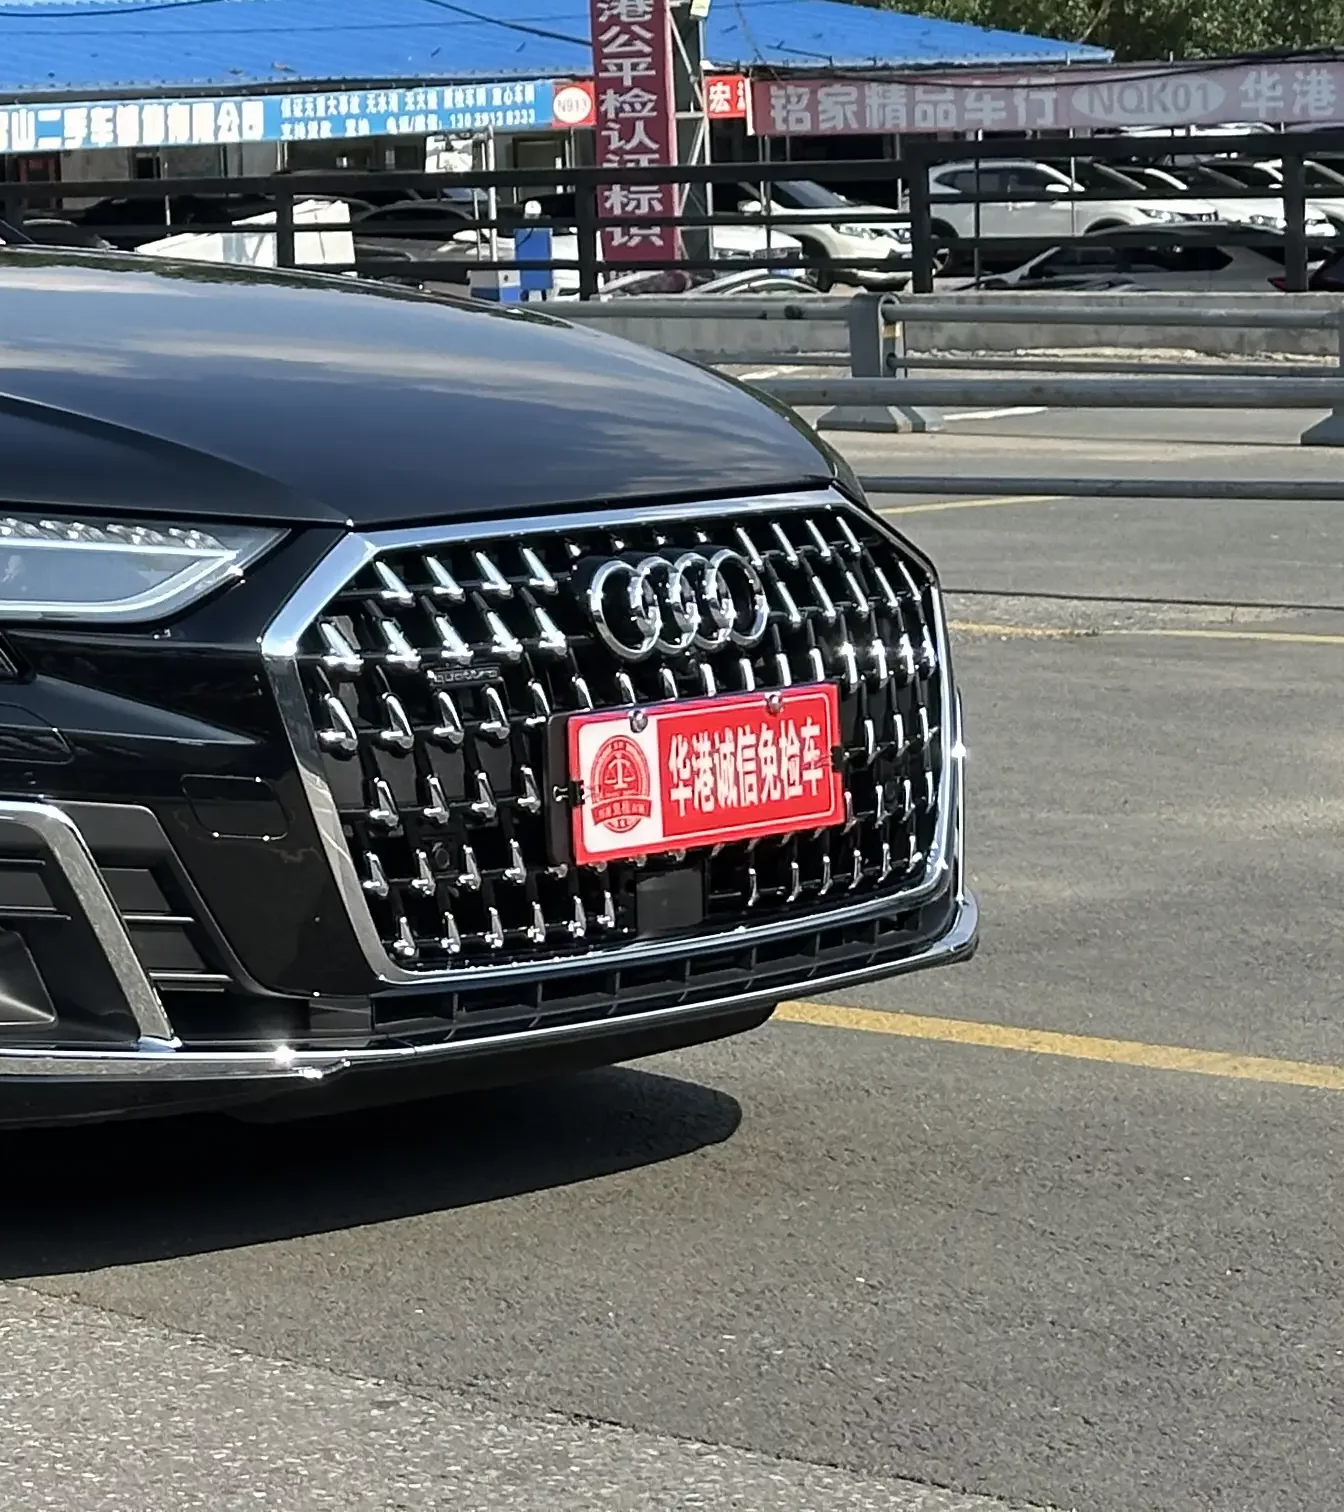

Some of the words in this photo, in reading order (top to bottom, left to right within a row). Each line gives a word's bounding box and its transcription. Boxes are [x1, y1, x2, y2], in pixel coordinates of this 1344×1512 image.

[770, 77, 1058, 130] 铭家精品车行
[1088, 80, 1211, 114] NQK01
[1239, 68, 1338, 118] 华港
[668, 716, 823, 817] 华港诚信免检车
